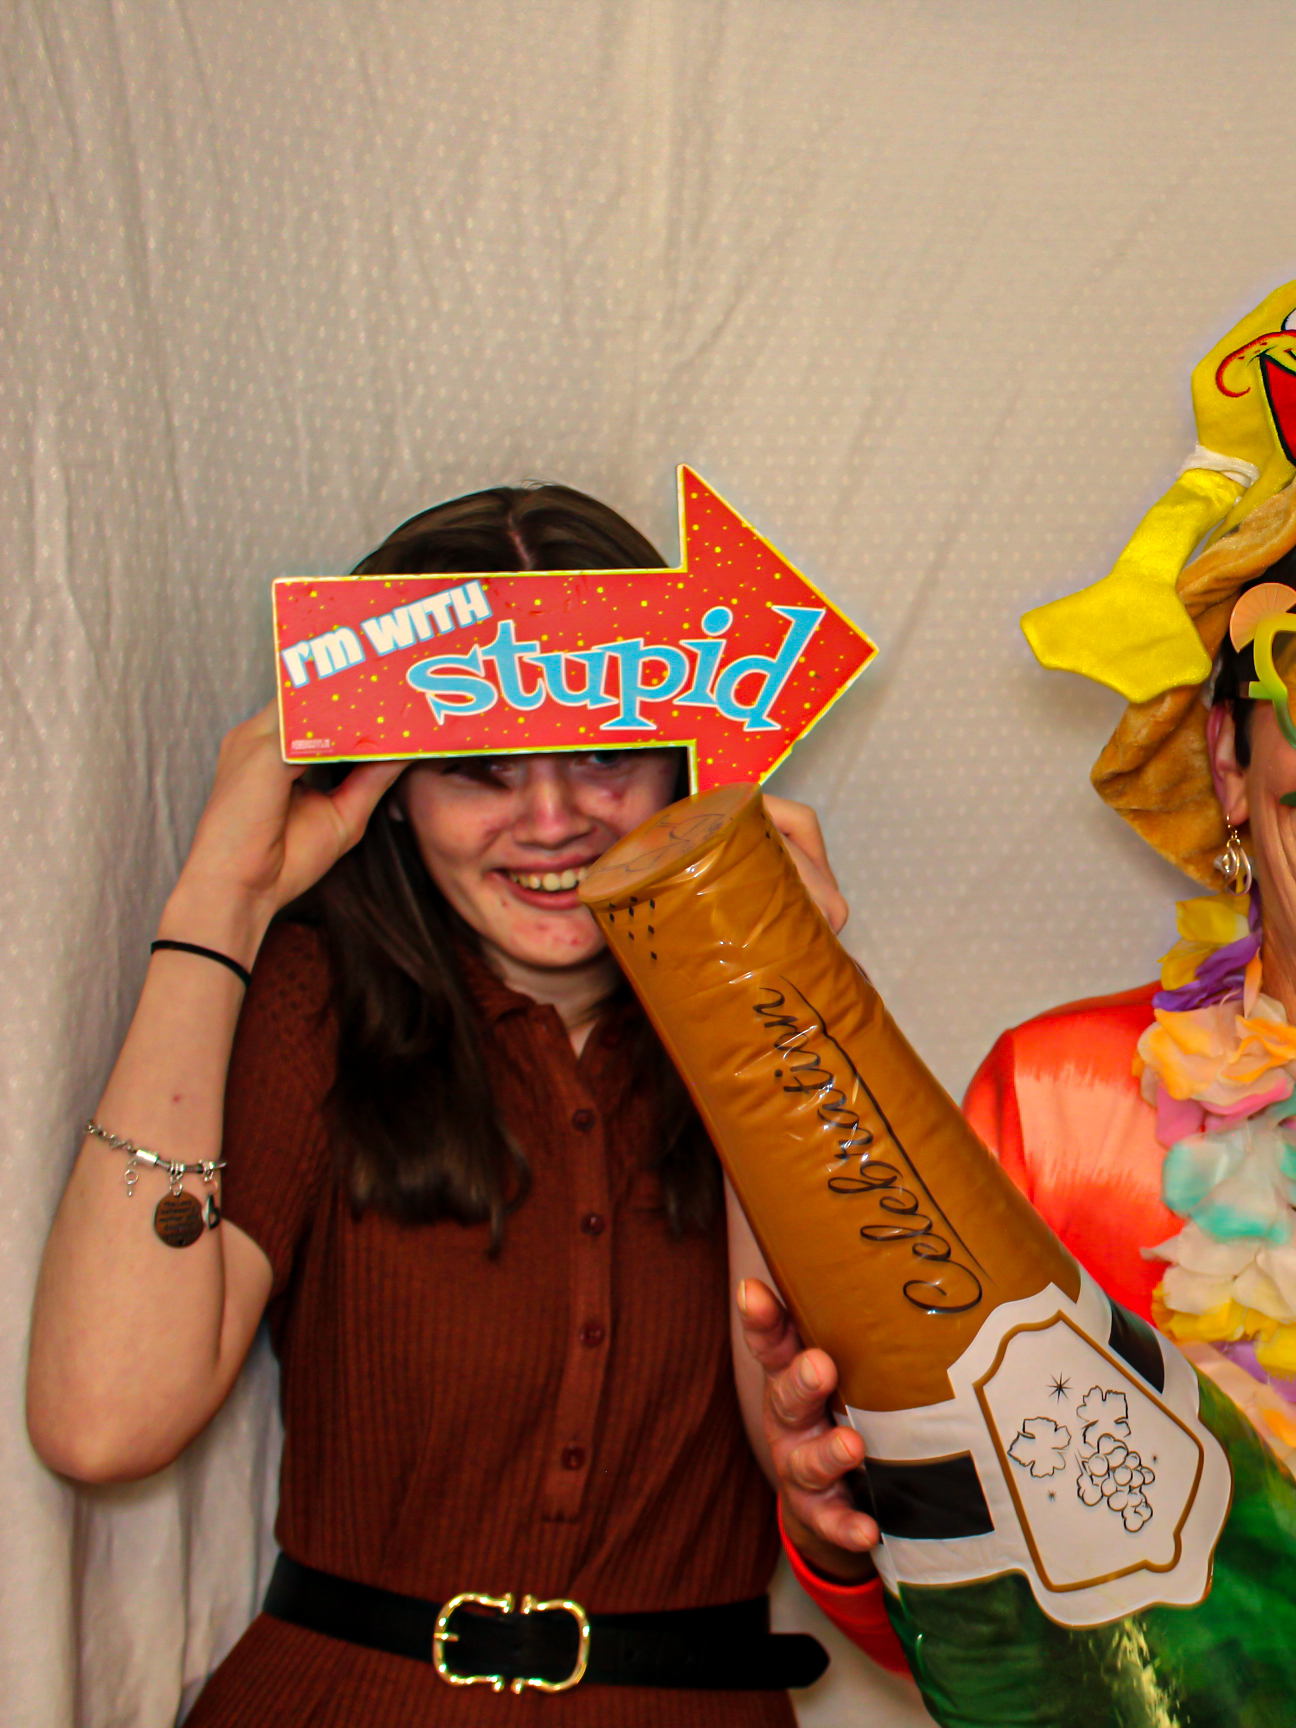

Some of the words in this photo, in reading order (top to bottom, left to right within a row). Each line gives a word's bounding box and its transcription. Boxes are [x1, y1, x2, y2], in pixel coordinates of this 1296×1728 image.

[360, 579, 493, 656] WITH
[406, 606, 826, 731] stupid
[752, 986, 983, 1313] Celebration
